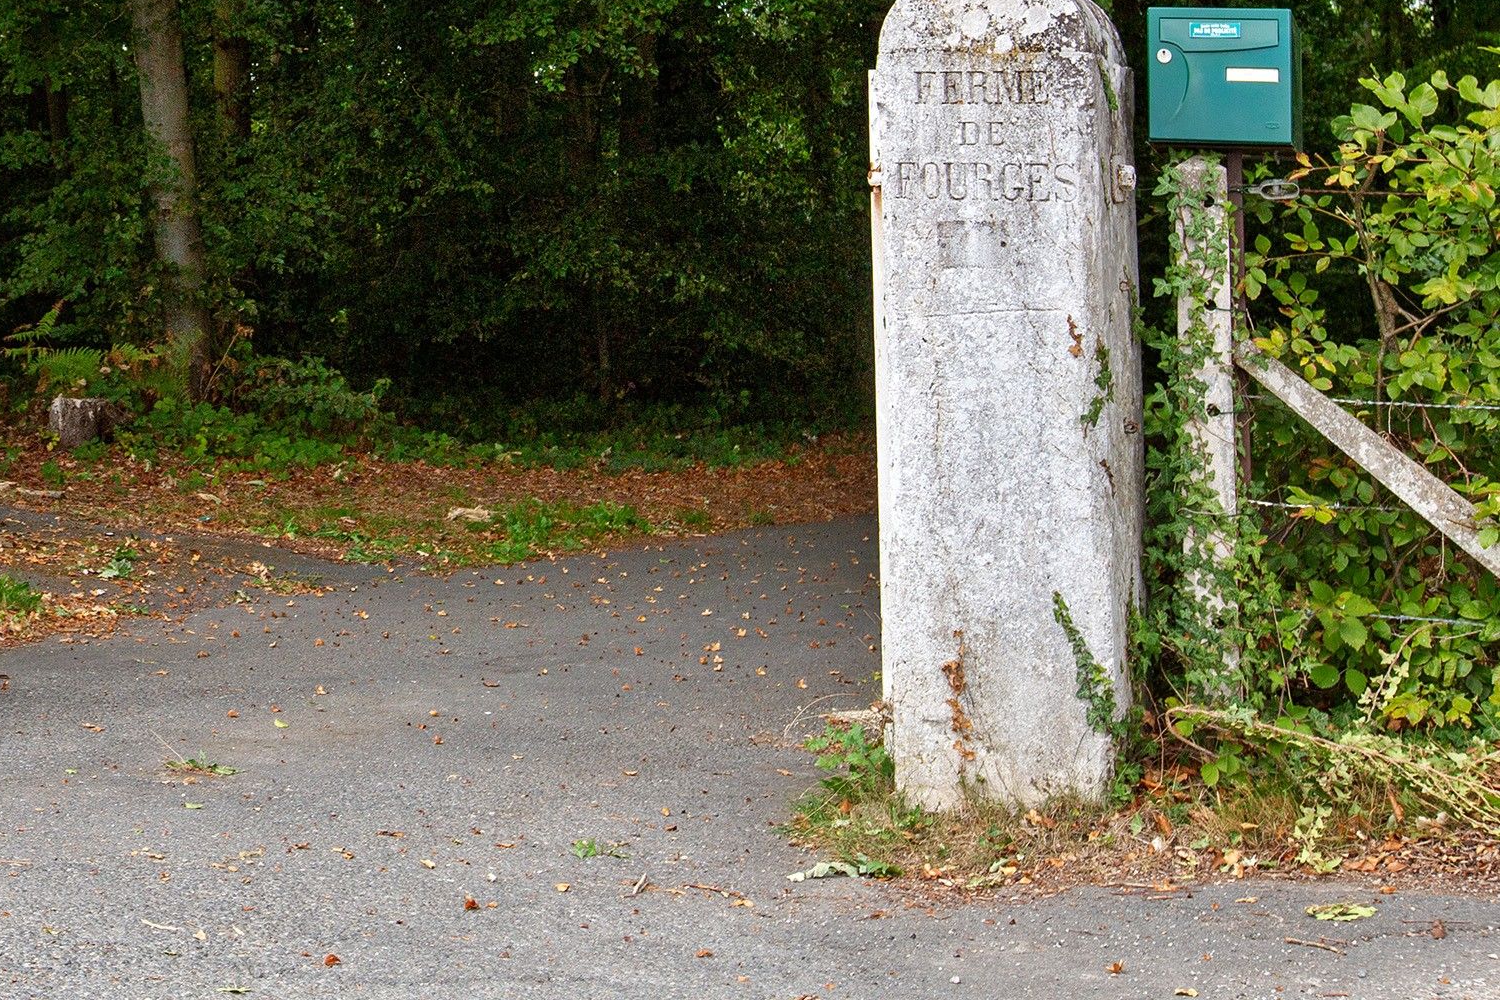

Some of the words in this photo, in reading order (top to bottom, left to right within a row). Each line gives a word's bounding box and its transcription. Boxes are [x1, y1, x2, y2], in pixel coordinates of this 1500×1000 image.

[913, 70, 1051, 105] FERME
[957, 121, 1005, 146] DE
[895, 161, 1078, 202] FOURGES
